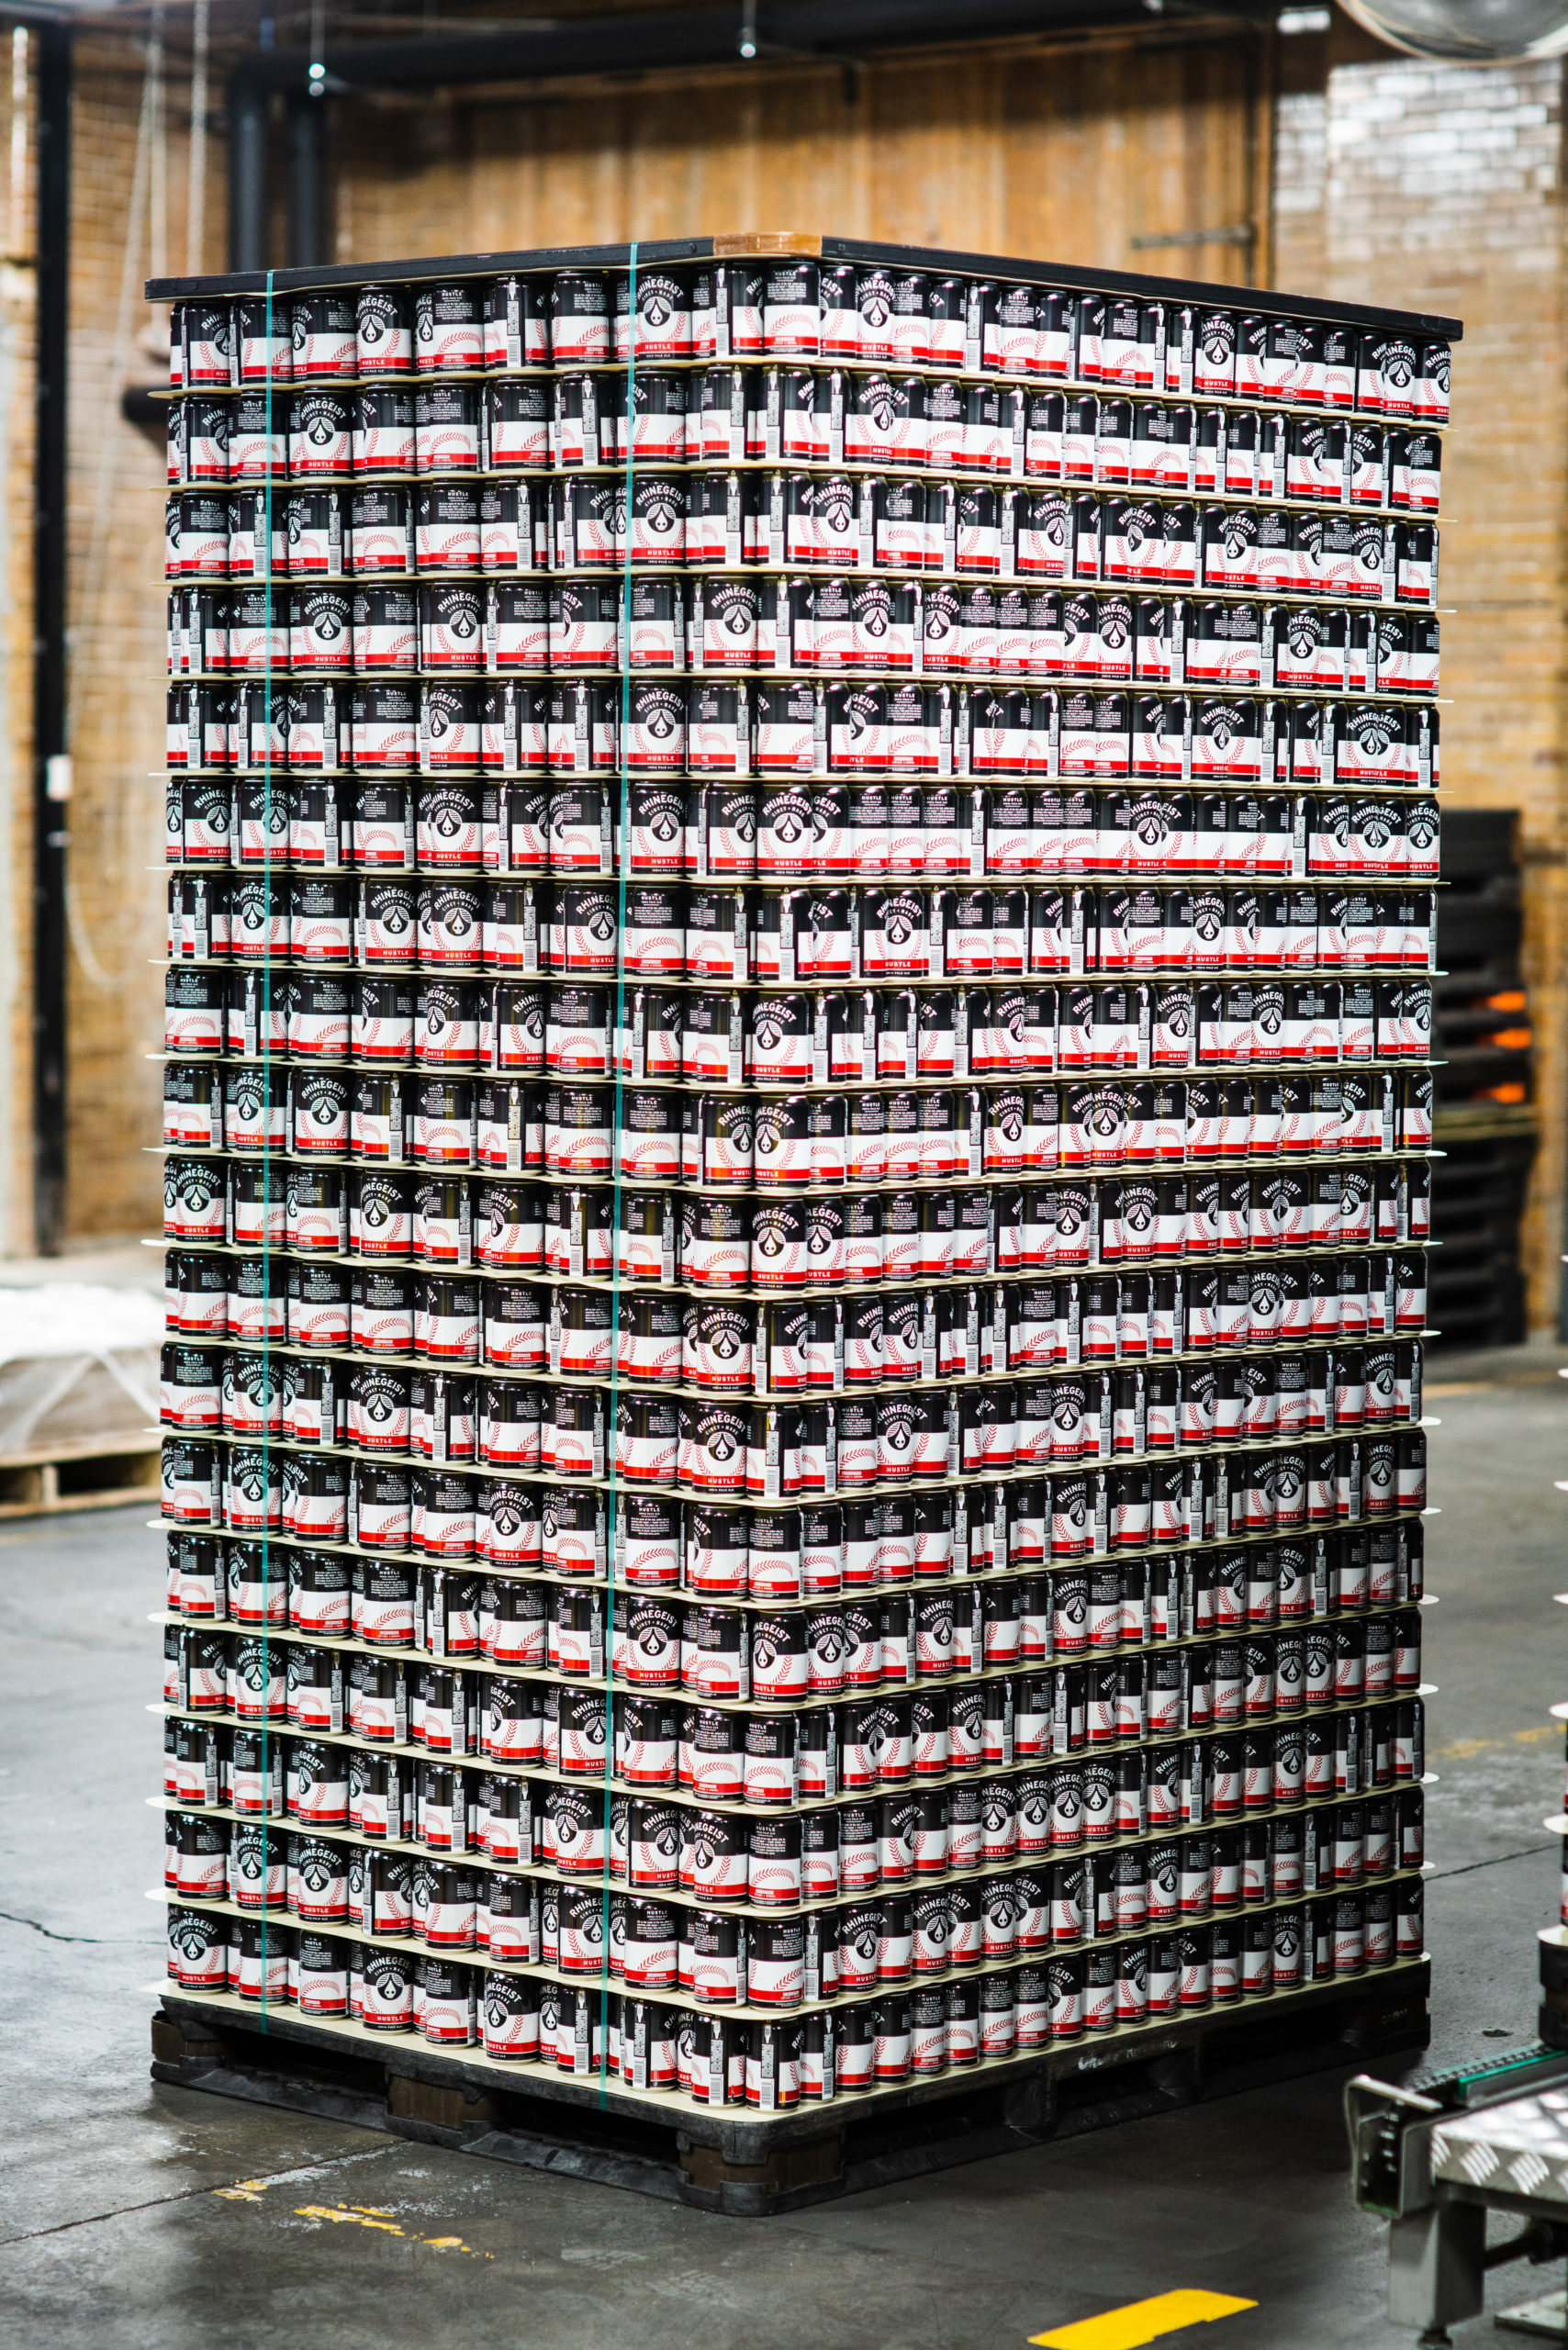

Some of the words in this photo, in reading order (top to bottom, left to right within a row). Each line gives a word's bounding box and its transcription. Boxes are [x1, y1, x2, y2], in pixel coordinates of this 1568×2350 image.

[1423, 351, 1450, 368] RHINEG
[635, 486, 683, 507] RHINEGEIST
[304, 596, 350, 615] RHINEGEIST
[635, 691, 684, 712] RHINEGEIST
[761, 795, 812, 816] RHINEGEIST
[1403, 990, 1430, 1008] RHINEG
[988, 1096, 1024, 1115] RHINEGE
[700, 1313, 749, 1331] RHINEGEIST
[696, 1415, 745, 1435] RHINEGEIST
[629, 1610, 678, 1629] RHINEGEIST
